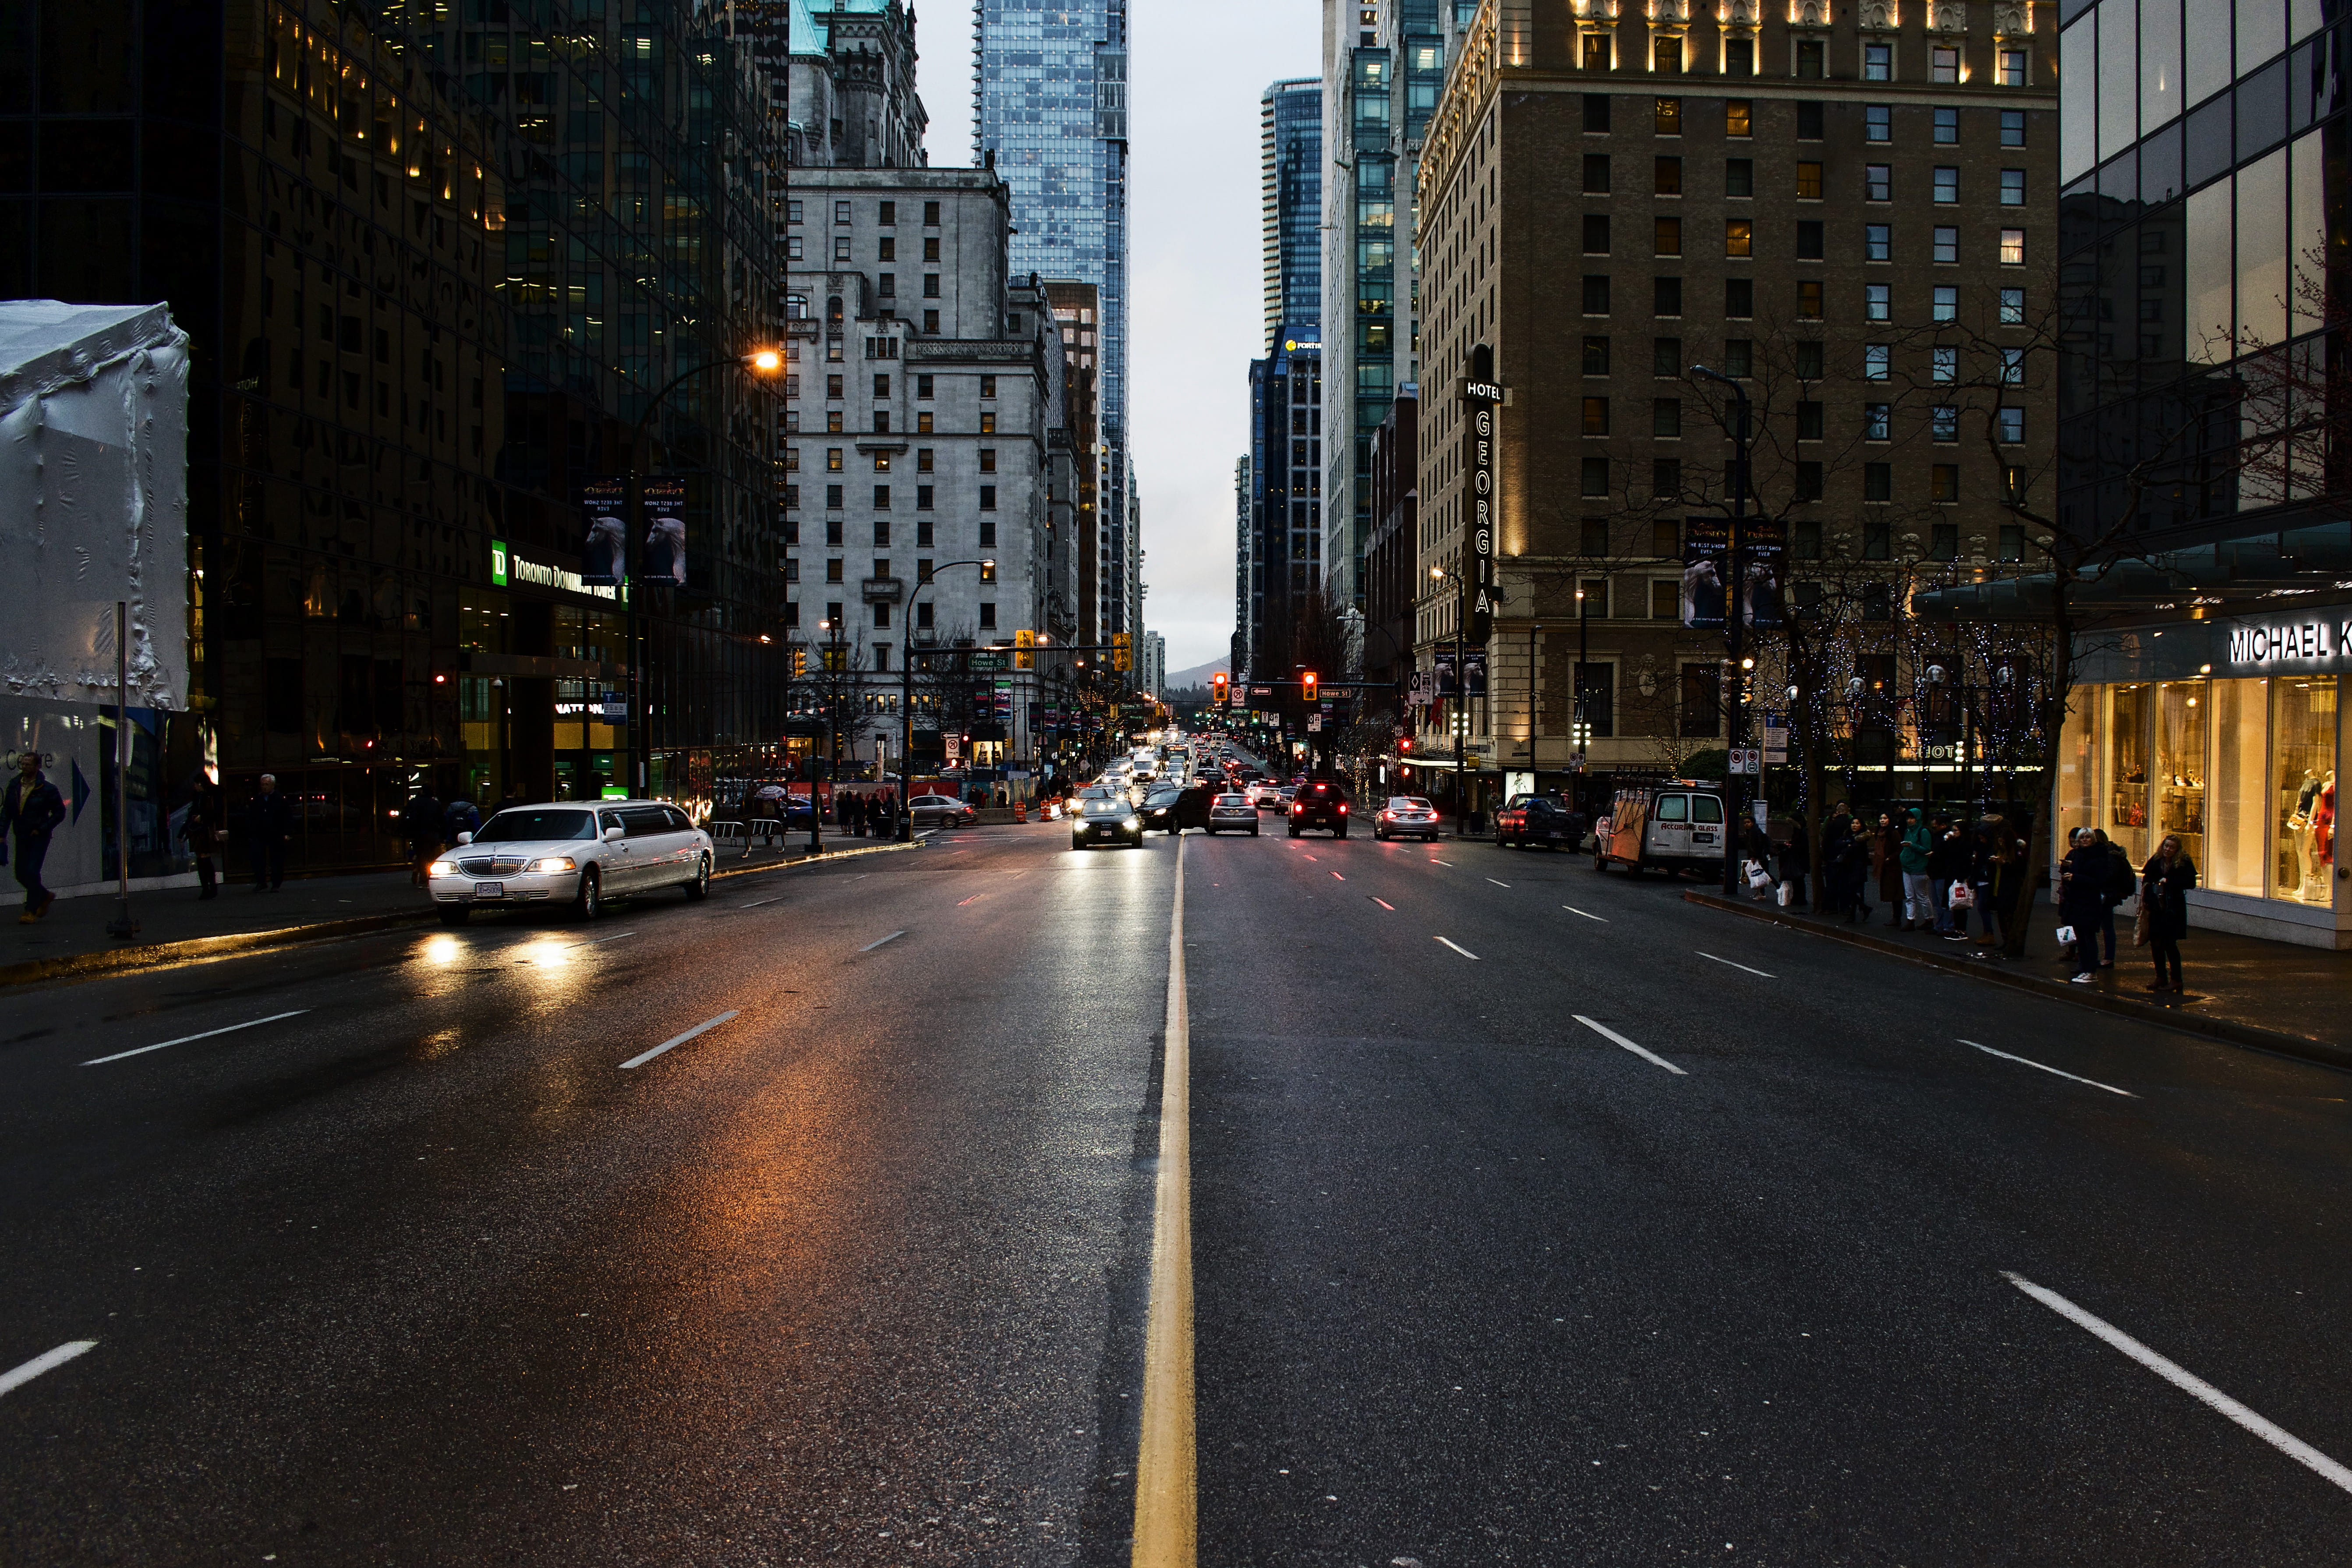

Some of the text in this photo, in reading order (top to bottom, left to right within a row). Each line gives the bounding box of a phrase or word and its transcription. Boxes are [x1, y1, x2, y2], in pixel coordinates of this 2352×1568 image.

[1468, 382, 1500, 400] HOTEL
[1475, 411, 1490, 613] GEORGIA
[492, 549, 506, 575] TD
[513, 555, 552, 586] TORONTO
[2229, 624, 2327, 662] MICHAEL
[1768, 717, 1775, 726] T
